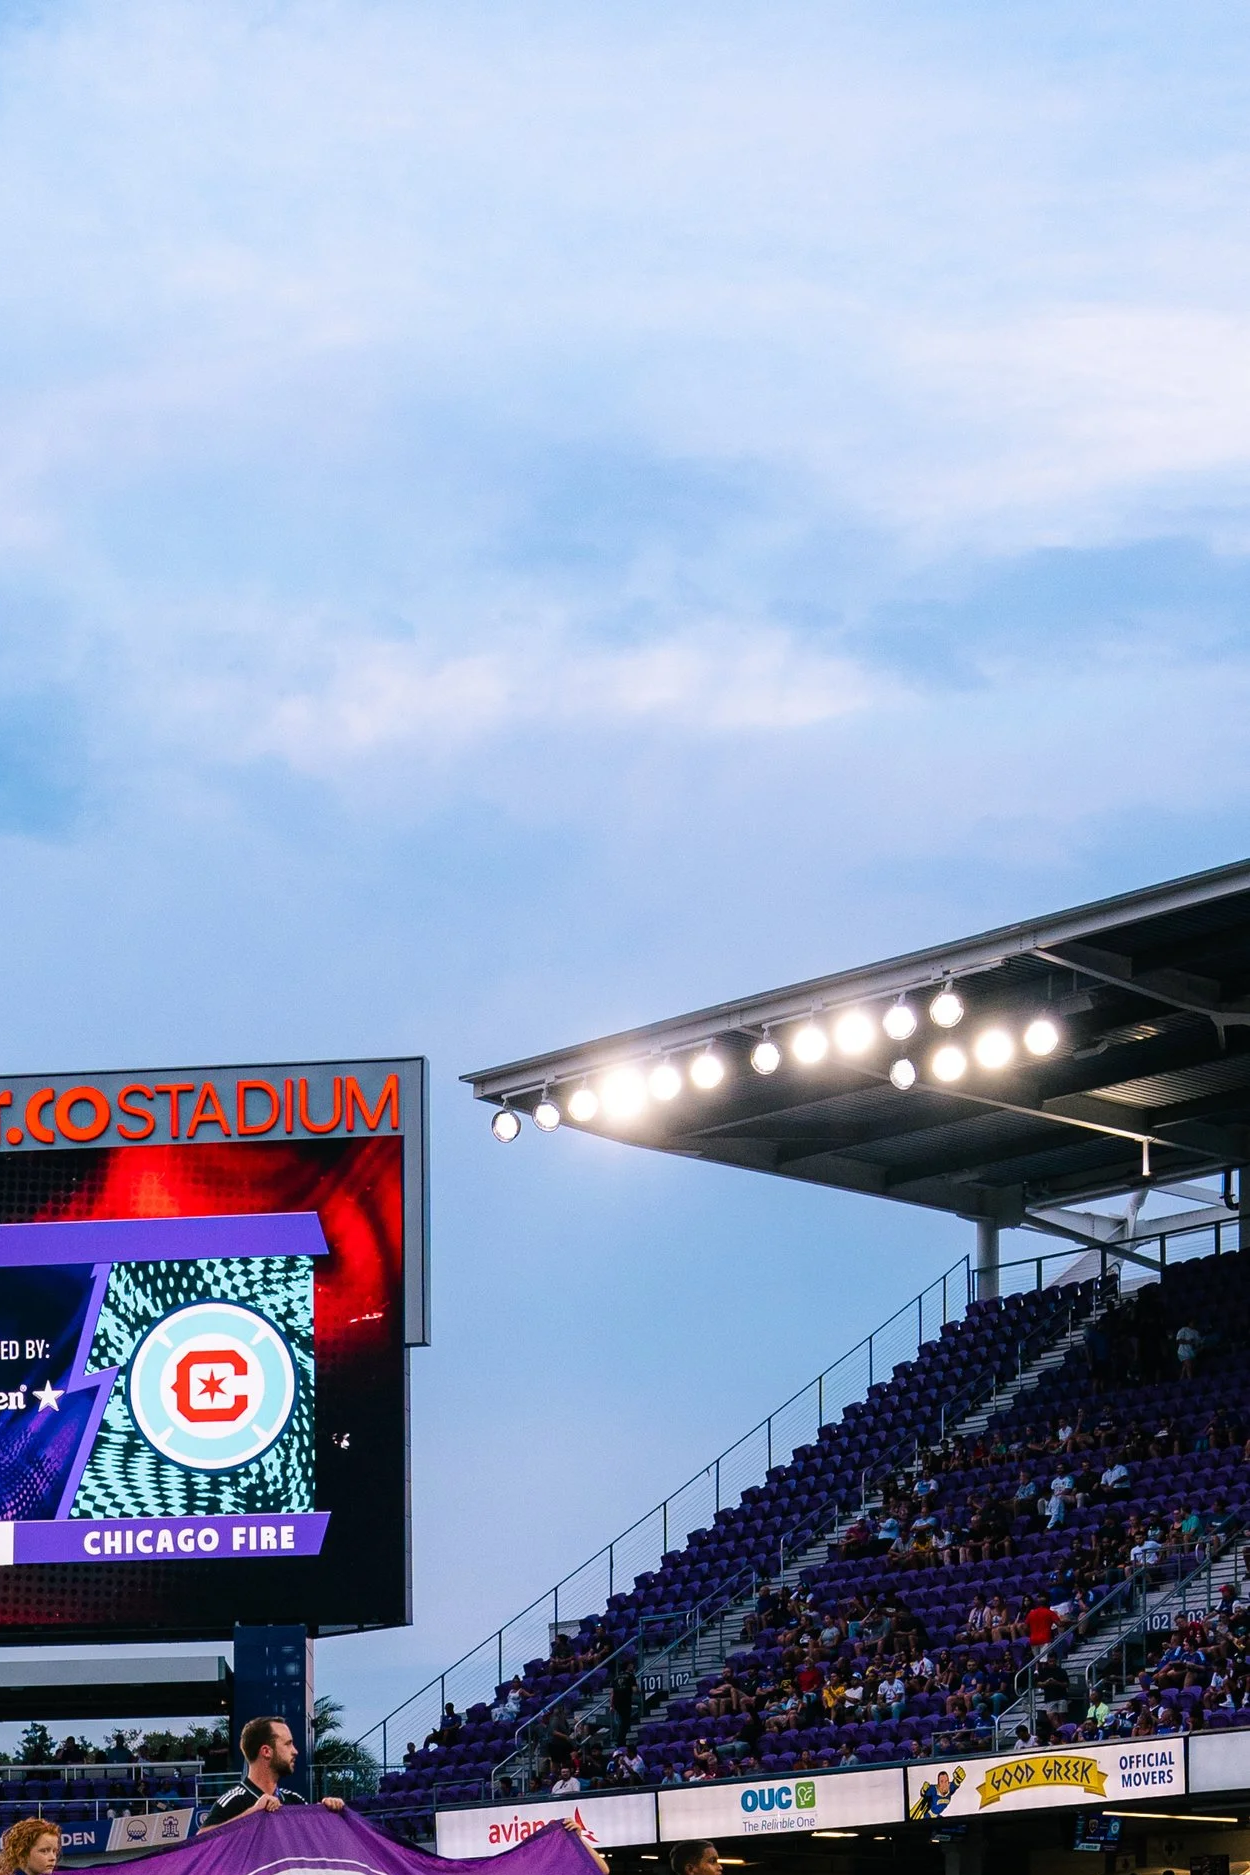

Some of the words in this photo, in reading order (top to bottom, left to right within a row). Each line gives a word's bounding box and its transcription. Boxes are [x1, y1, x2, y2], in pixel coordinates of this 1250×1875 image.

[117, 1073, 399, 1140] STADIUM
[25, 1339, 50, 1360] BY:
[83, 1527, 219, 1555] CHICAGO
[232, 1525, 295, 1551] FIRE
[1145, 1614, 1169, 1631] 102
[643, 1676, 661, 1690] 101
[670, 1673, 690, 1688] 102
[1119, 1751, 1175, 1770] OFFICIAL
[991, 1763, 1035, 1791] GOOD
[1042, 1759, 1093, 1785] GREEK
[1121, 1769, 1174, 1788] MOVERS
[741, 1786, 792, 1813] OUC
[743, 1821, 759, 1832] The
[797, 1816, 815, 1828] One
